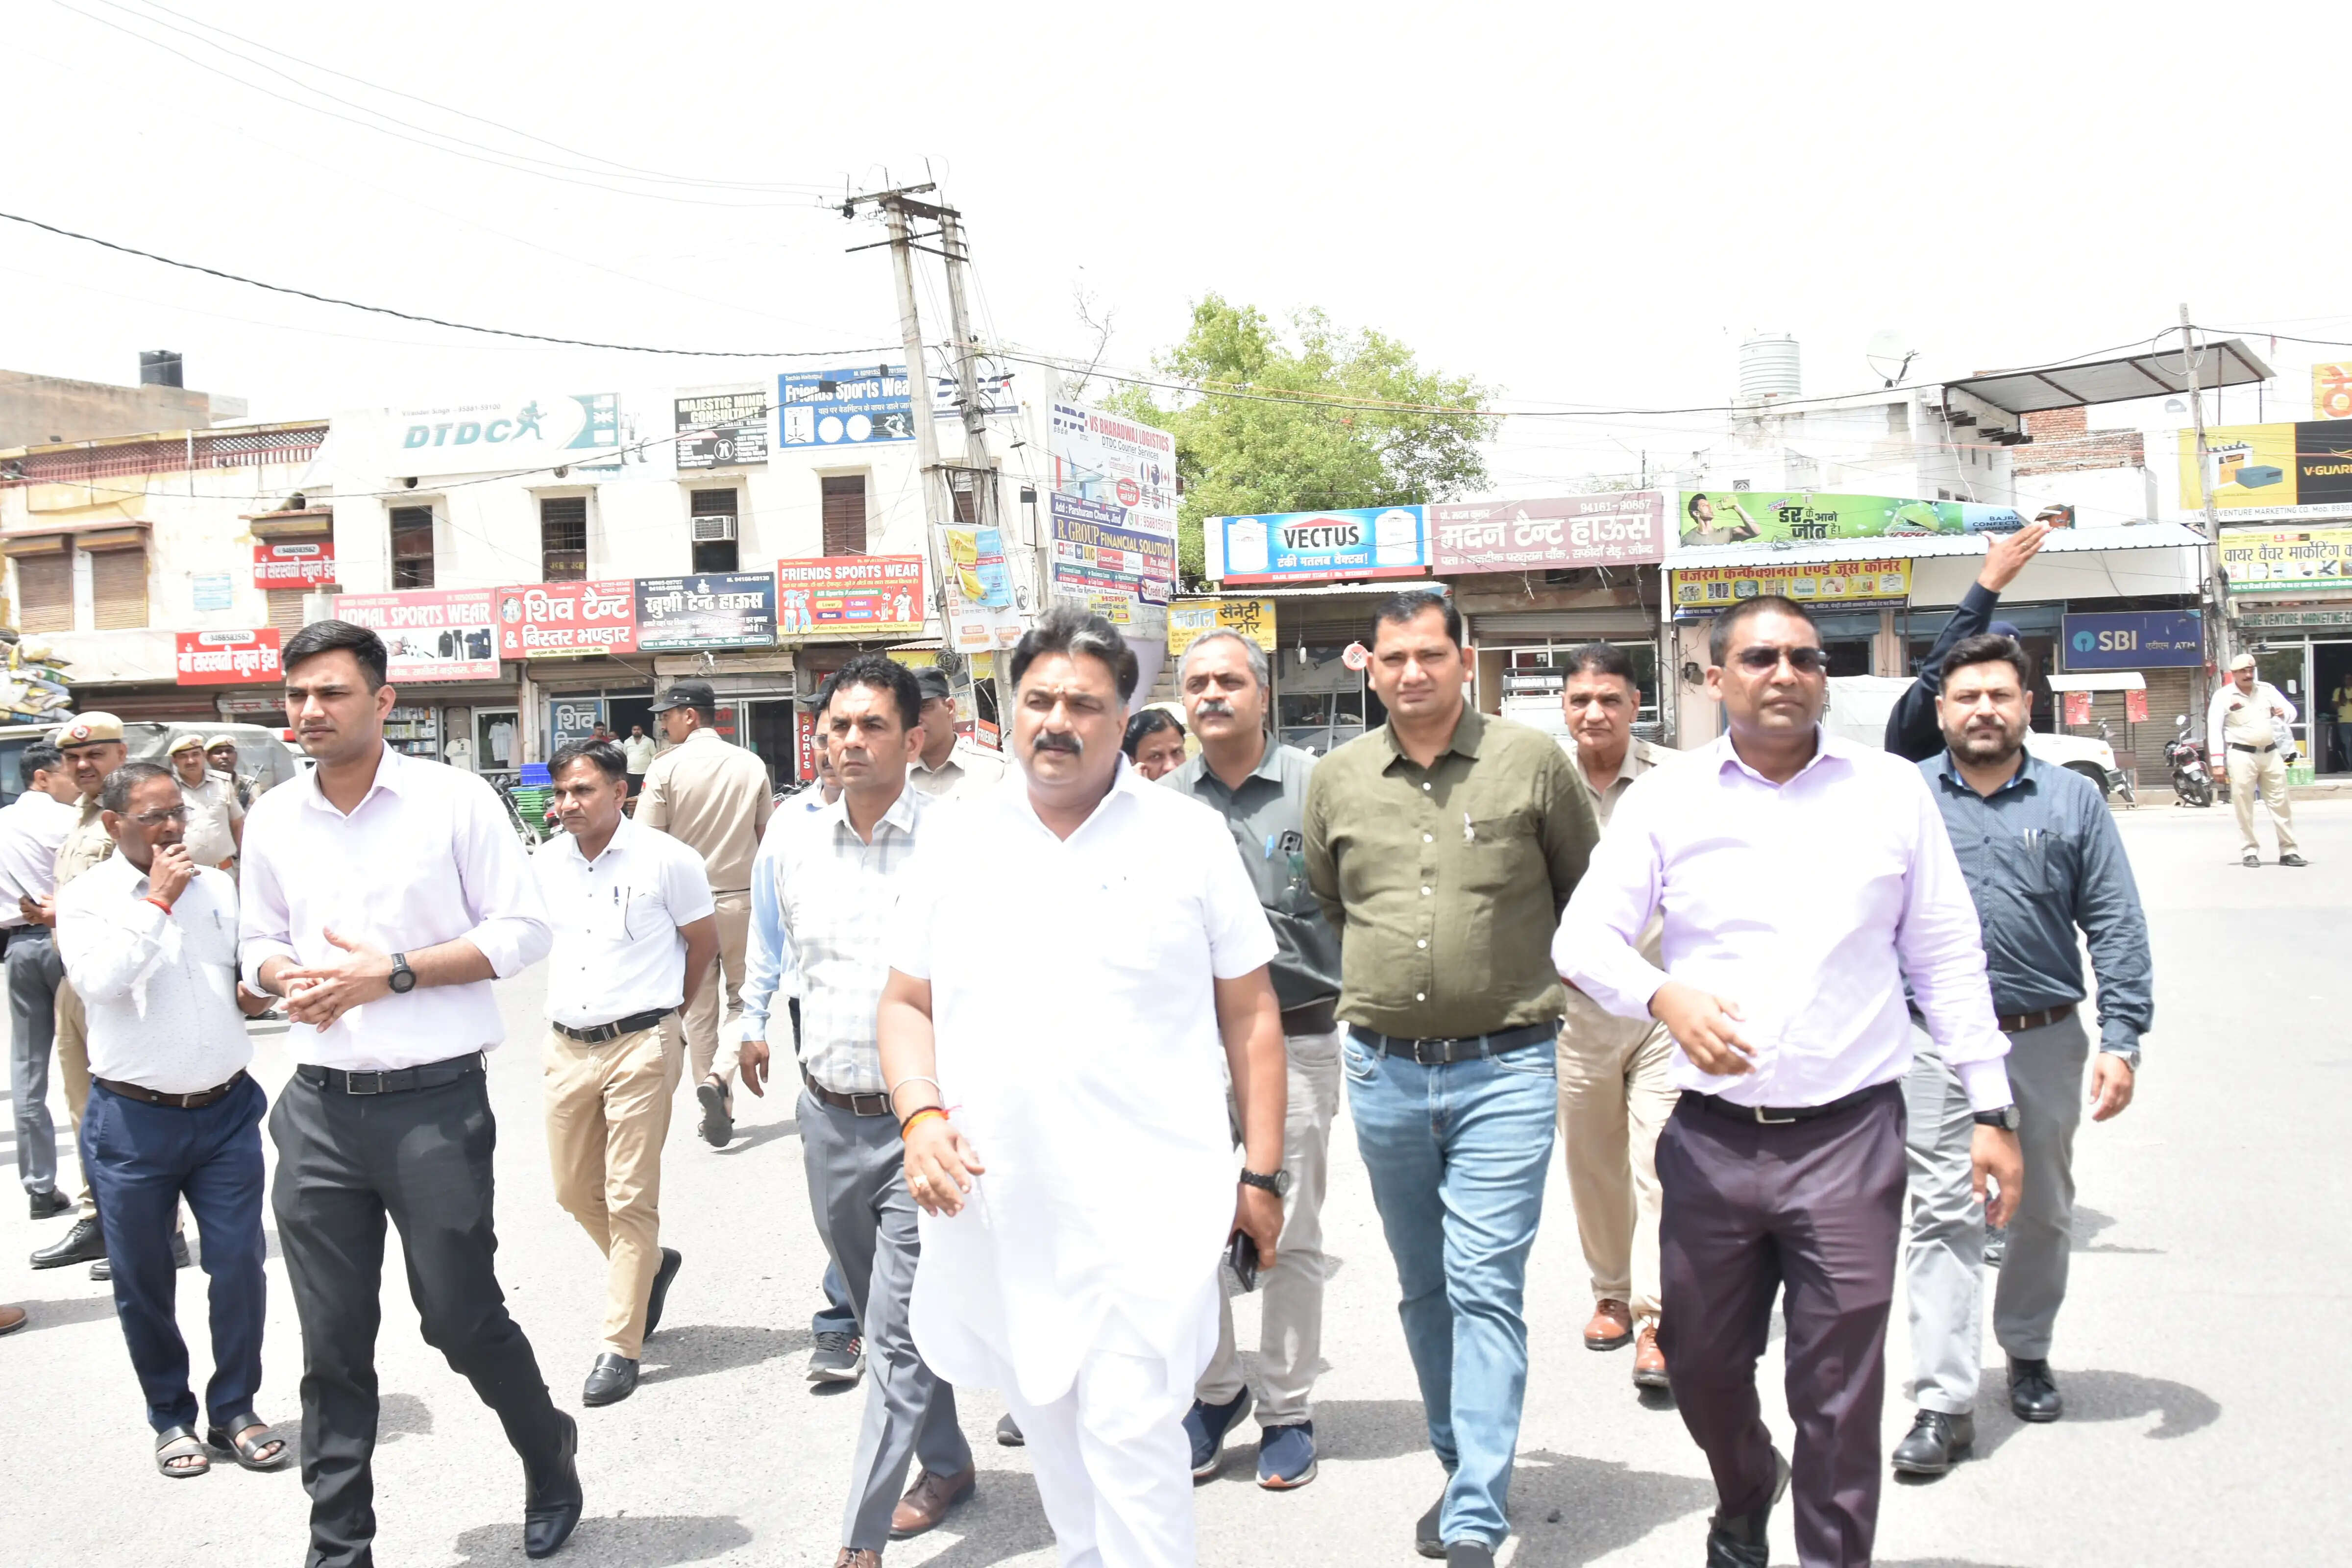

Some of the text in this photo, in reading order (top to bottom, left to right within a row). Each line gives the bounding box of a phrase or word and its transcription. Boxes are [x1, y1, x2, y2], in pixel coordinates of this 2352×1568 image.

[836, 380, 879, 402] Sports
[882, 378, 911, 396] Wea
[679, 396, 732, 413] MAJESTIC
[691, 407, 760, 423] CONSULTANT
[401, 418, 513, 449] DTDC
[1089, 415, 1169, 452] VS BHARADWAJ LOGISTICS
[1102, 435, 1159, 460] DTDC Courier Services
[1055, 501, 1065, 512] Add
[1068, 504, 1093, 518] Parshuram
[1094, 510, 1111, 523] Chowk,
[1111, 513, 1121, 524] Jind
[1134, 514, 1139, 524] M
[1777, 506, 1839, 523] डर के आगे
[2219, 509, 2253, 517] VENTURE
[2255, 507, 2297, 516] MARKETING
[1057, 519, 1067, 539] R.
[1068, 521, 1100, 544] GROUP
[1100, 533, 1138, 552] FINANCIAL
[1284, 525, 1359, 549] VECTUS
[1439, 509, 1654, 549] मदन टैन्ट हाऊस
[1789, 518, 1841, 539] जीत है!
[1084, 546, 1095, 560] LIC
[1278, 553, 1298, 567] टंकी
[1300, 555, 1331, 566] मतलब
[1441, 554, 1458, 567] पता
[2224, 548, 2254, 562] वायर
[2289, 540, 2340, 559] मार्केटिंग
[782, 564, 919, 580] FRIENDS SPORTS WEAR
[1835, 562, 1860, 577] जूस
[1148, 585, 1160, 596] Credit
[522, 586, 631, 623] शिव टैन्ट
[644, 590, 764, 618] खुशी टैन्ट हाऊस
[1219, 601, 1261, 620] सैनेट्री
[338, 602, 491, 629] KOMAL SPORTS WEAR
[2264, 612, 2299, 625] VENTURE
[504, 630, 518, 649] &
[521, 623, 574, 647] बिस्तर
[577, 626, 631, 645] भण्डार
[2099, 630, 2196, 651] SBI एटीएम ATM
[178, 642, 194, 672] माँ
[193, 644, 232, 672] सरस्वती
[233, 649, 260, 677] स्कूल
[555, 704, 597, 730] शिव
[802, 715, 811, 769] SPORTS
